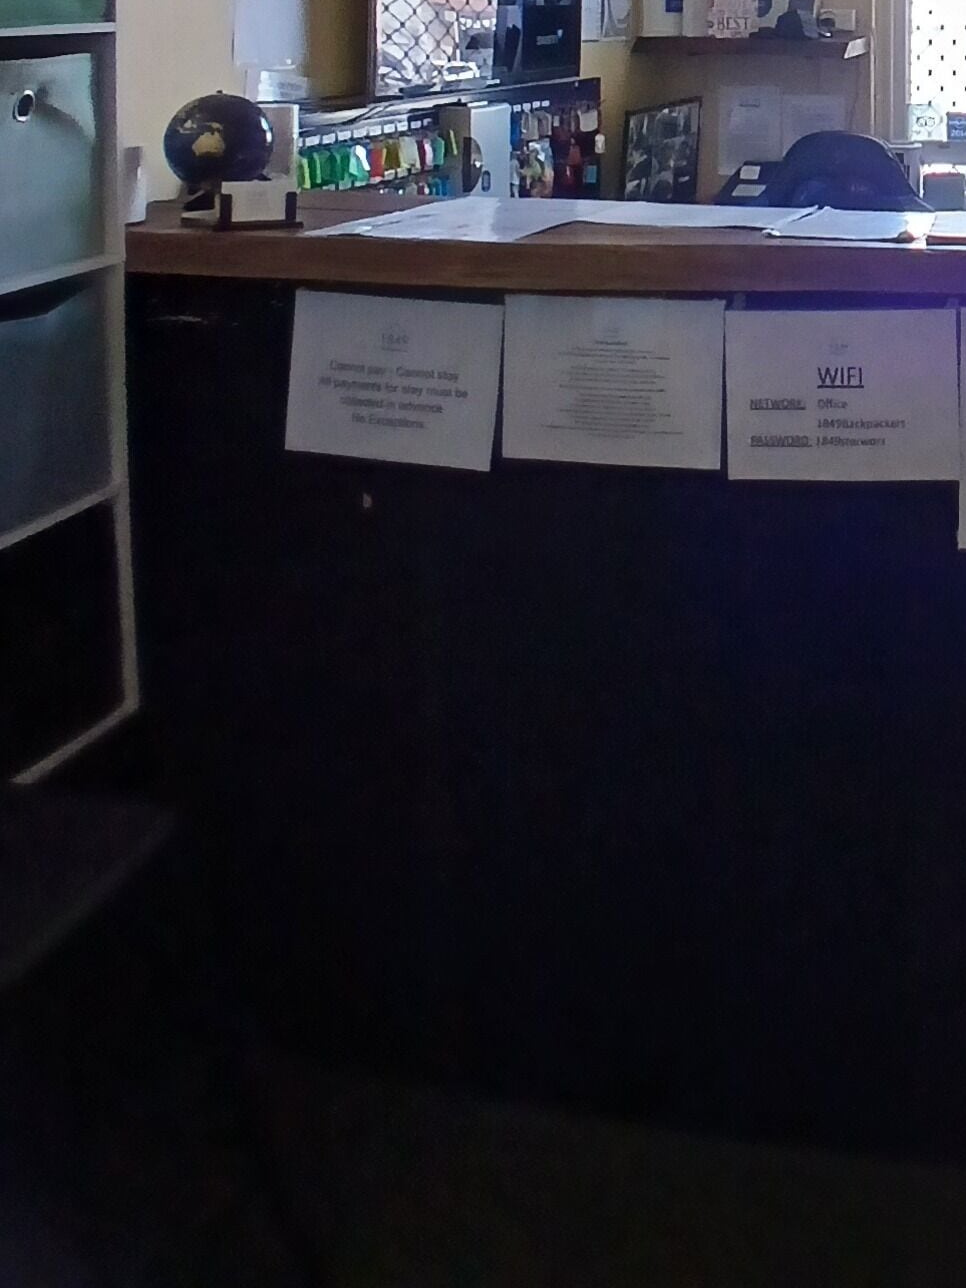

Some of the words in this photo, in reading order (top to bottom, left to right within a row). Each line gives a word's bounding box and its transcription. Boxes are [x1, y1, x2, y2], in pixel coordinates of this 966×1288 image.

[717, 17, 749, 31] BEST
[817, 366, 864, 388] WIFI
[817, 398, 849, 410] Office
